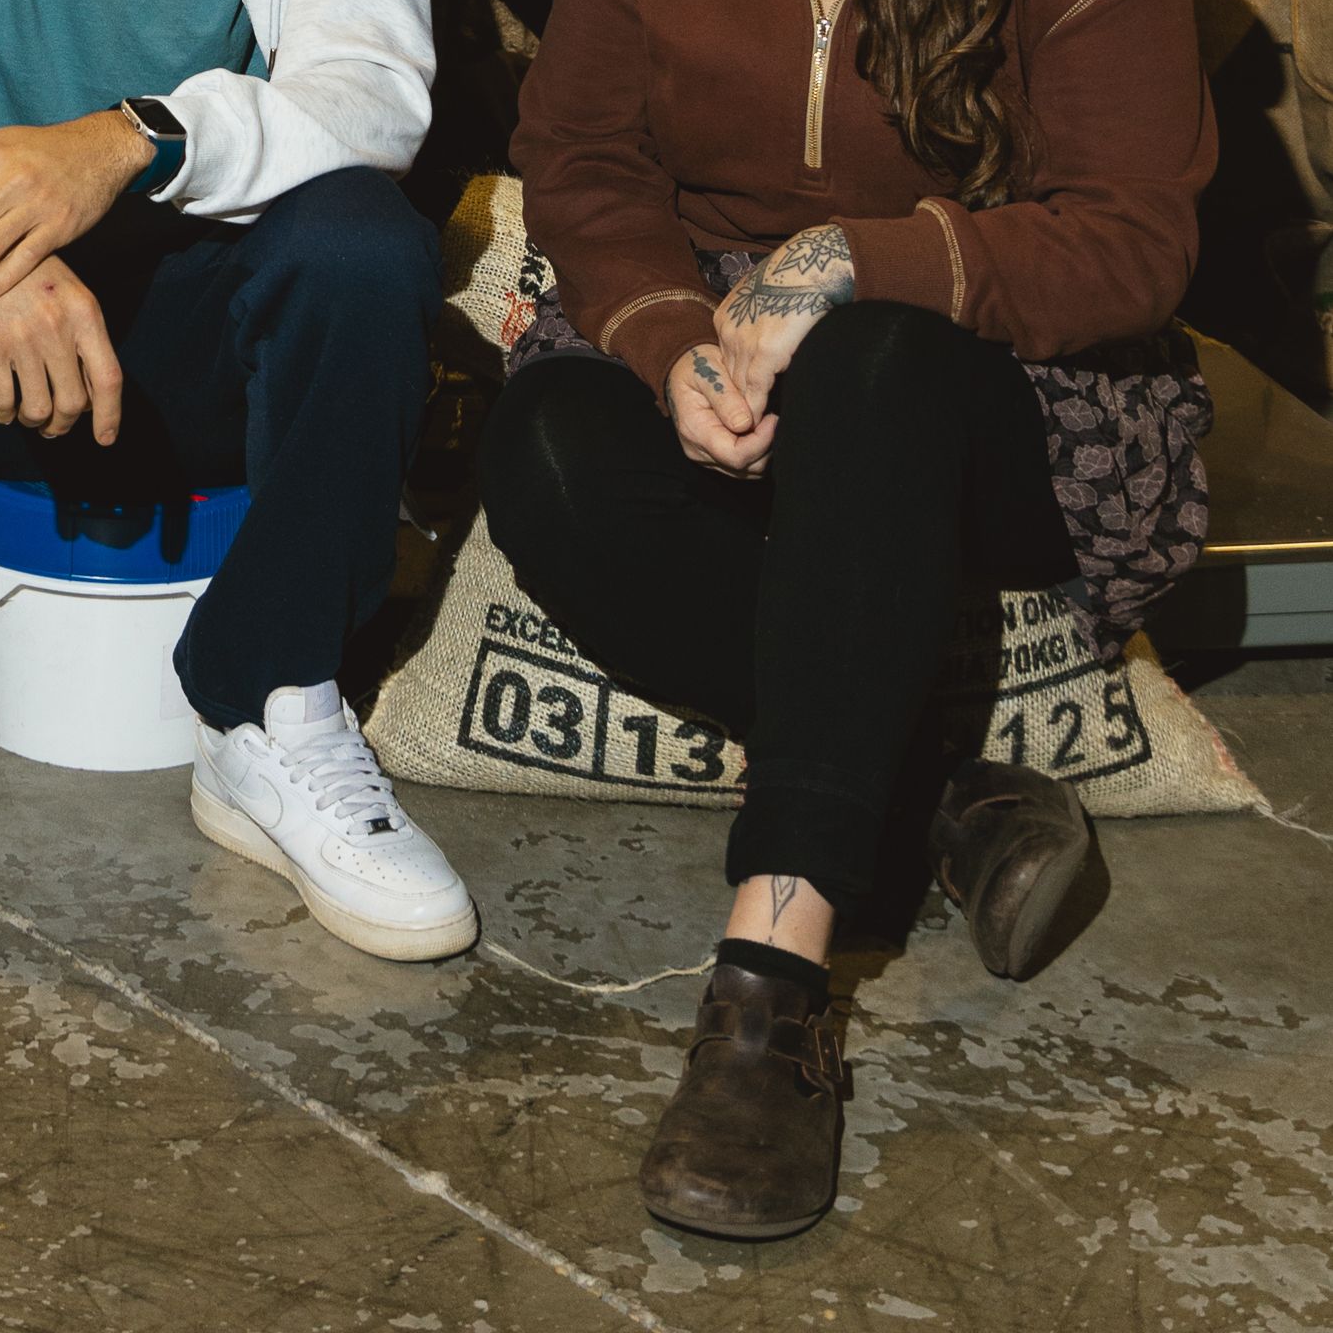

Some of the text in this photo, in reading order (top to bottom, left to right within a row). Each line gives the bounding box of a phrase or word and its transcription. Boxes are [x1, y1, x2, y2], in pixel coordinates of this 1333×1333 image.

[481, 669, 1135, 783] 03 13 125
